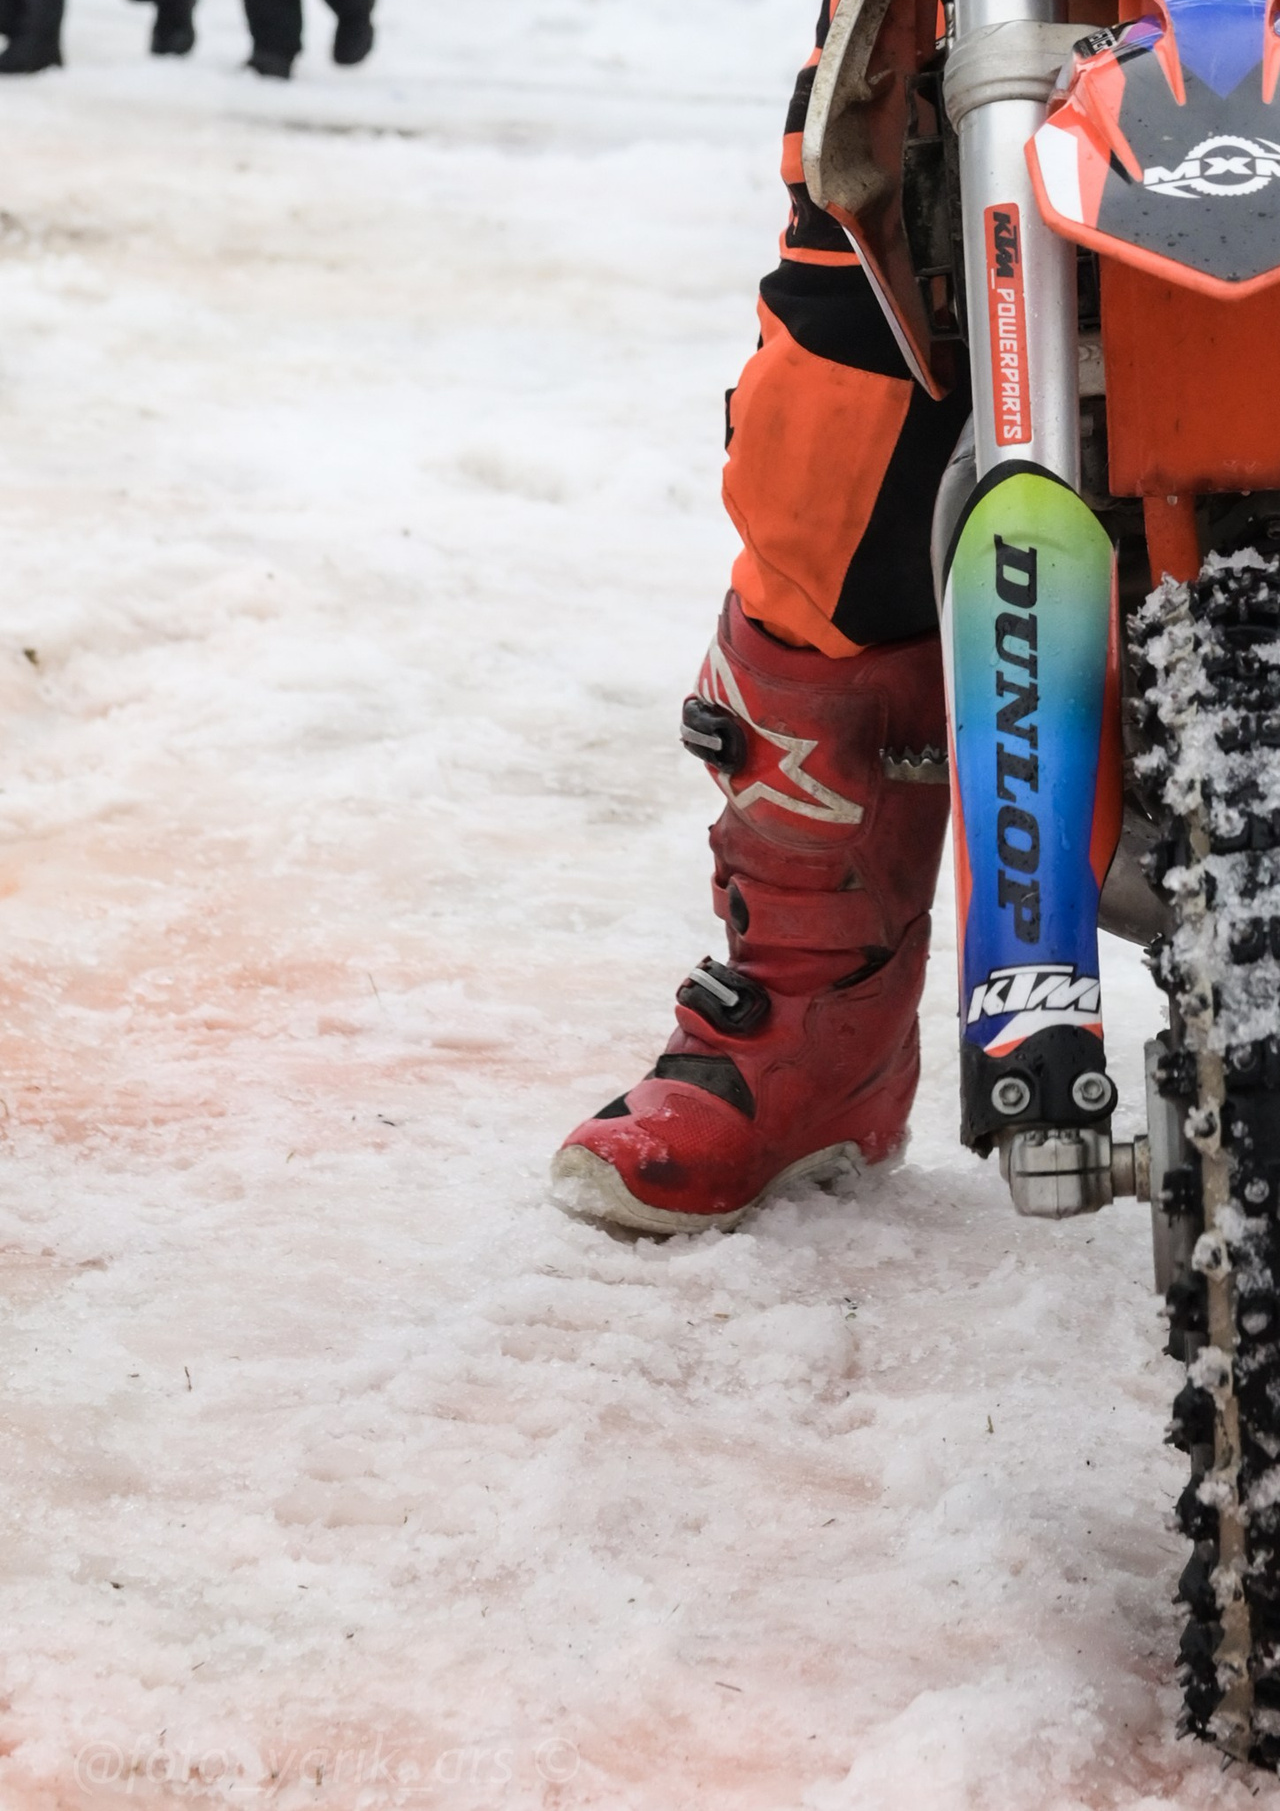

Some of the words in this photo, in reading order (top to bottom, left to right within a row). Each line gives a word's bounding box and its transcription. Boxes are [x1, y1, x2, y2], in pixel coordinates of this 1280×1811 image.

[992, 211, 1018, 278] KTM
[997, 288, 1022, 440] POWERPARTS
[994, 534, 1041, 946] DUNLOP
[966, 963, 1102, 1026] KTM
